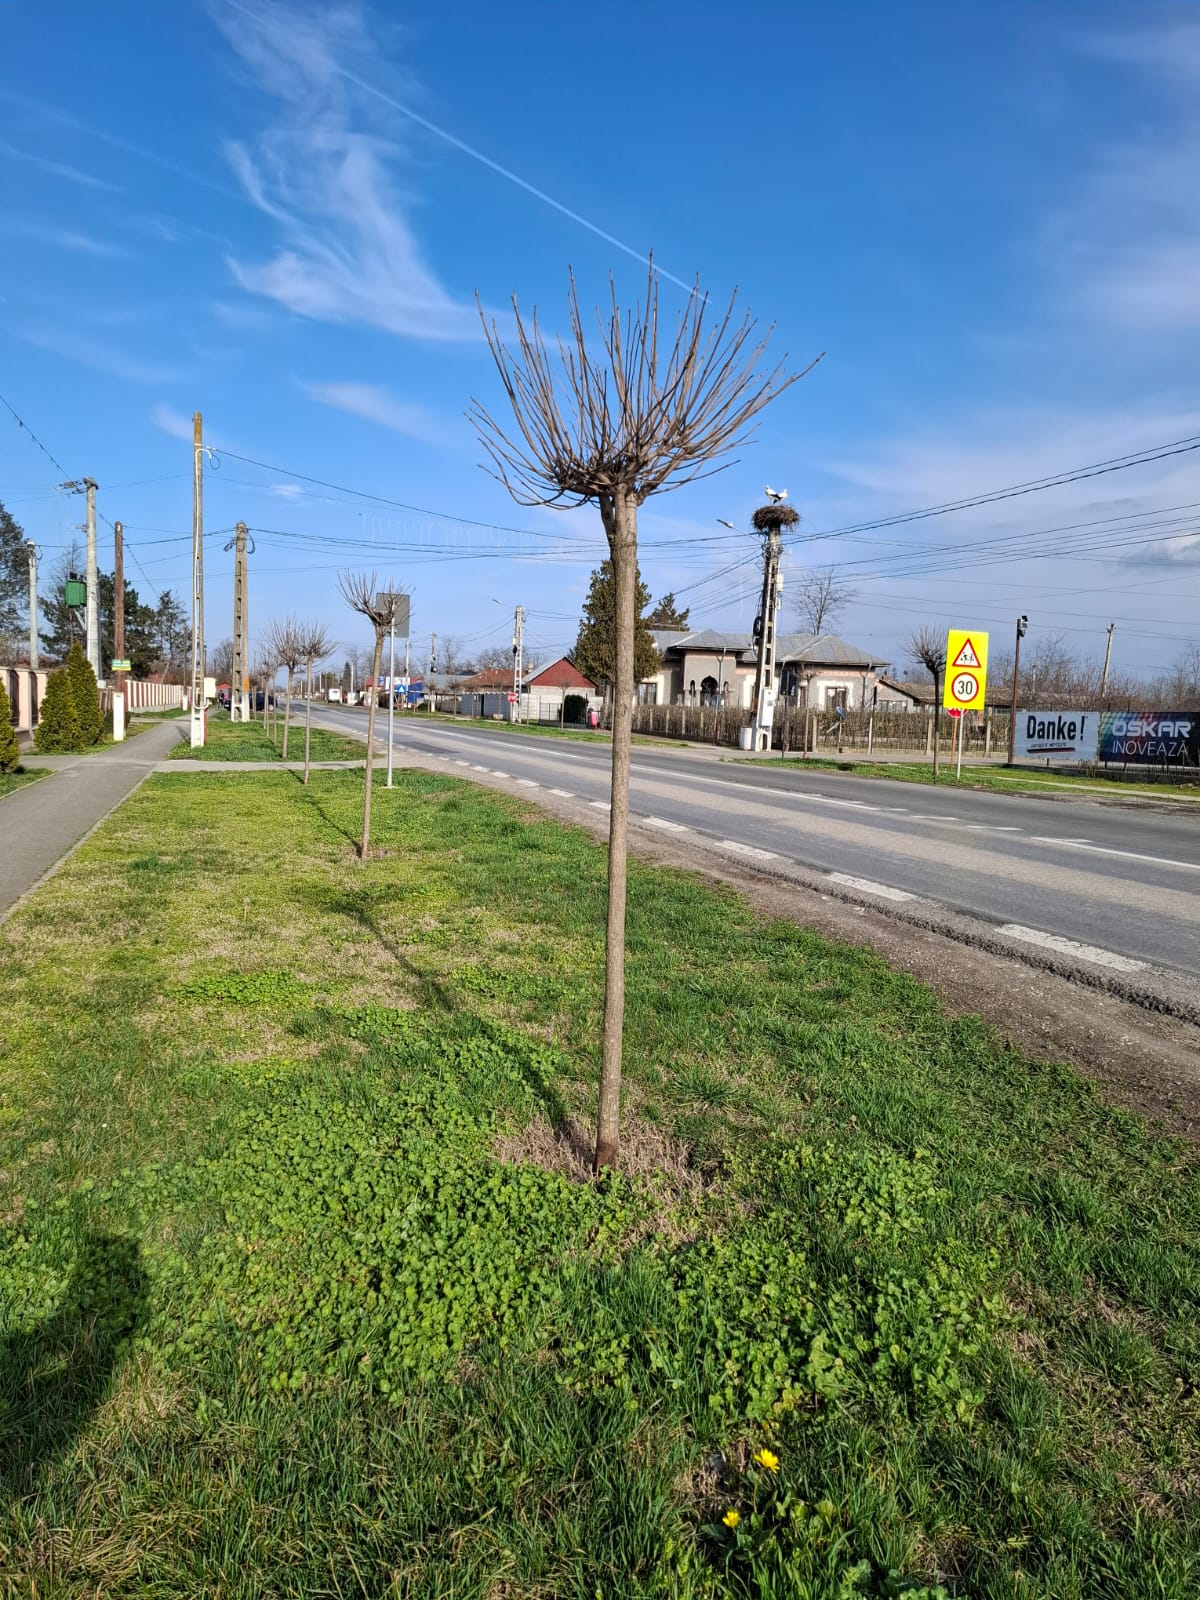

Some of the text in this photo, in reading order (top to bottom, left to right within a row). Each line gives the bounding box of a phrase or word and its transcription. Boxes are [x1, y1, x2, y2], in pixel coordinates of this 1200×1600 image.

[958, 680, 973, 695] 30
[1112, 721, 1192, 738] OSKAR
[1112, 740, 1189, 757] INOVEAZĂ
